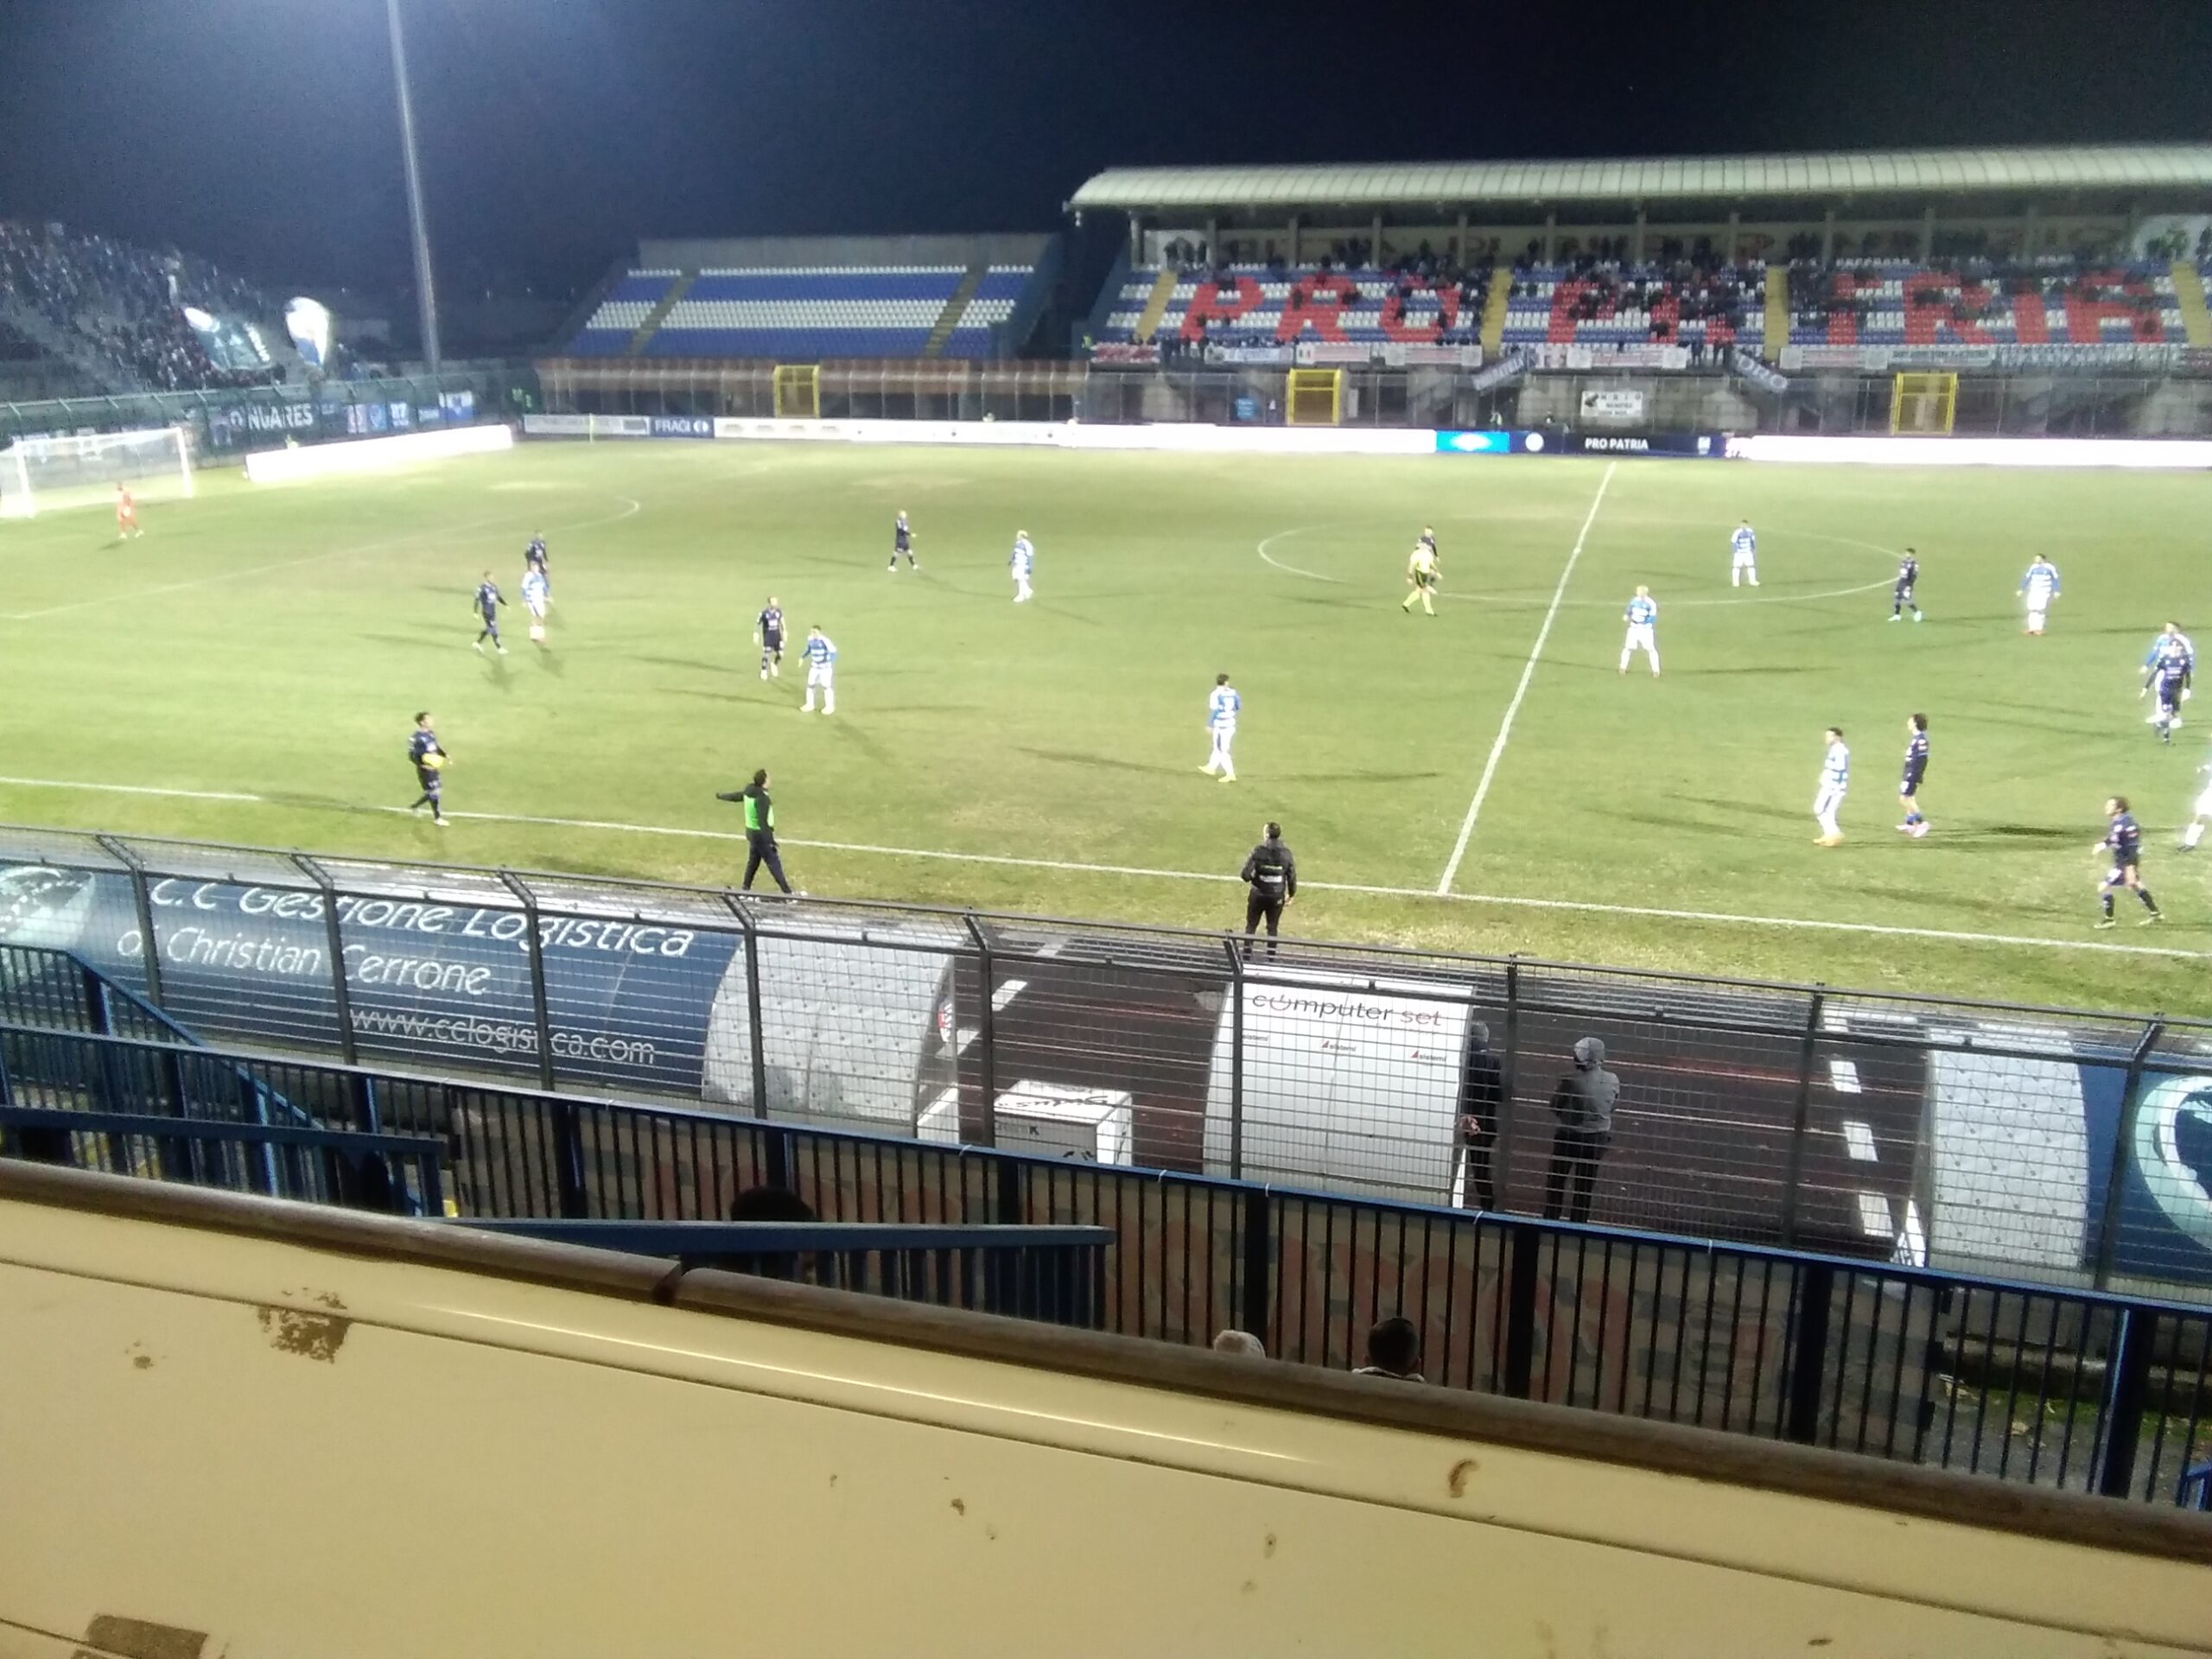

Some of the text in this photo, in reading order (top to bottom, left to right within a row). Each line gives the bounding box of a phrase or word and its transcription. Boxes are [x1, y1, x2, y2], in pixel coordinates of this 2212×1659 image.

[1585, 437, 1649, 450] PRO PATRIA
[167, 926, 321, 976] Christian
[1252, 994, 1442, 1027] computer set
[349, 1008, 655, 1065] www.cclogistca.com
